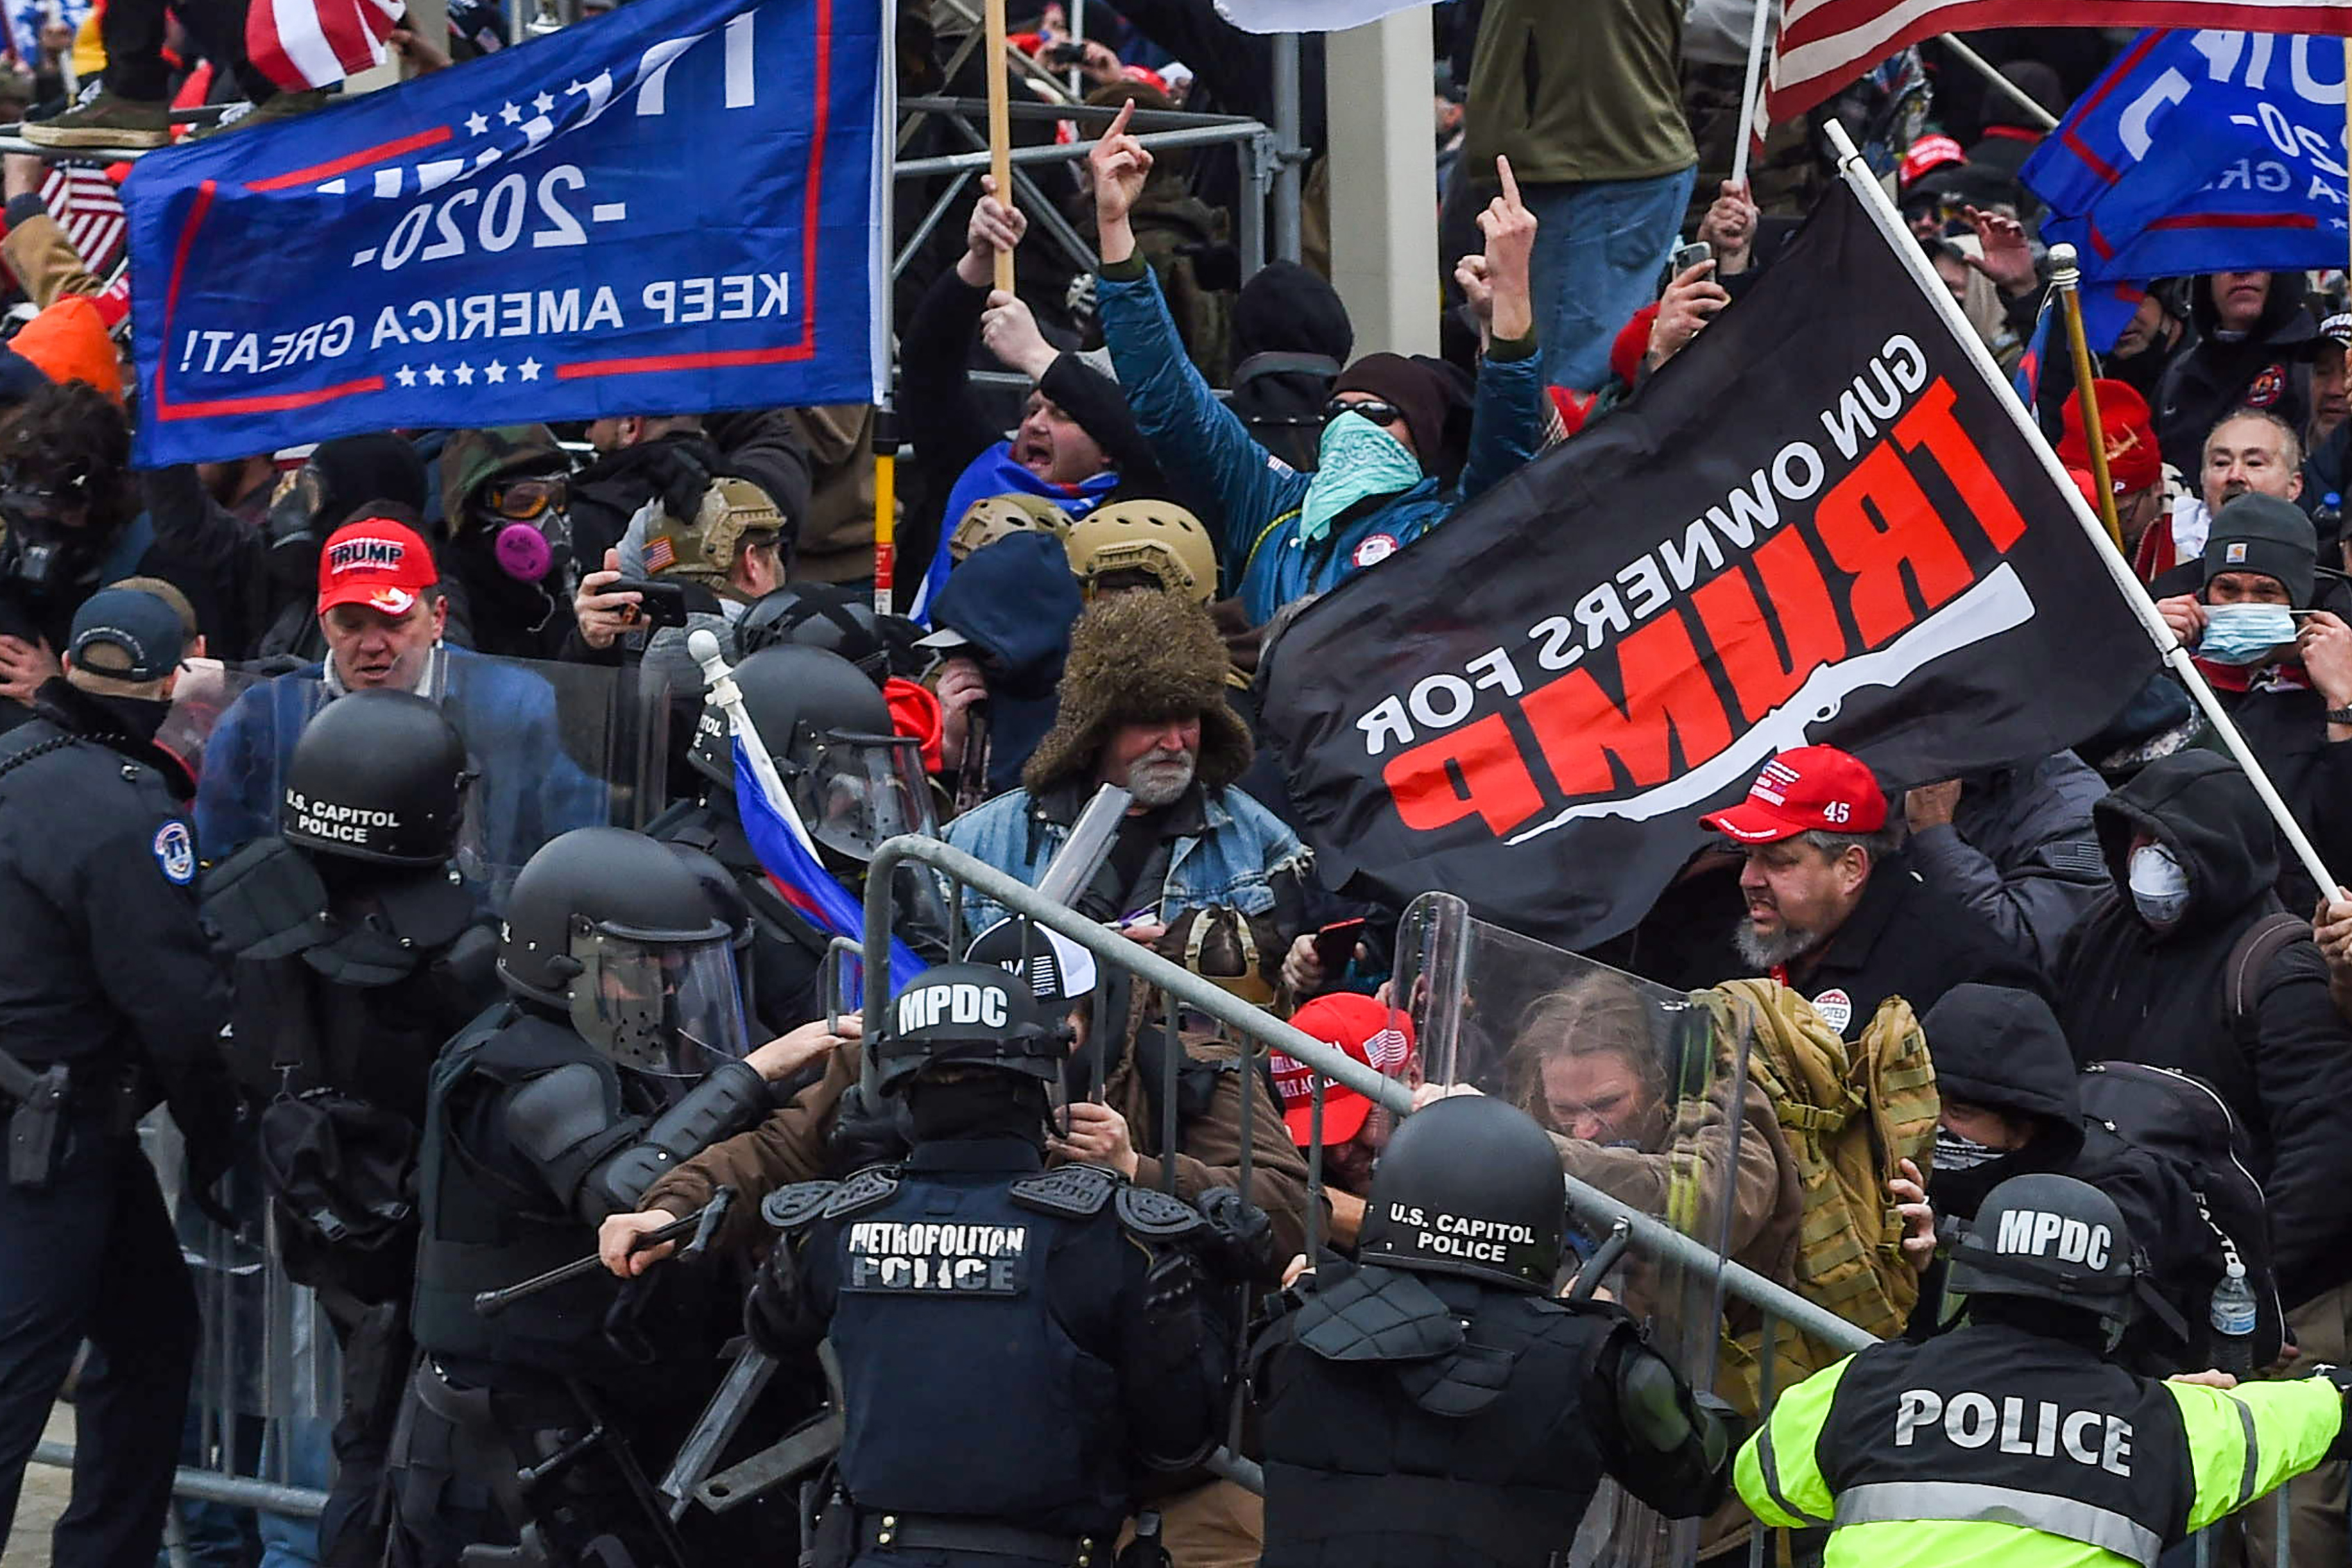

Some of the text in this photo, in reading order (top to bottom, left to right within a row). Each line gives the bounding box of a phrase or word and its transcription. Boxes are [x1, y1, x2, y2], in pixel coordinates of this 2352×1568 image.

[328, 543, 404, 567] TRUMP
[298, 814, 368, 843] POLICE
[312, 801, 401, 827] CAPITOL
[1823, 801, 1851, 823] 45
[898, 983, 1008, 1037] MPDC
[849, 1223, 1026, 1257] METROPOLITAN
[1390, 1203, 1535, 1243] U.S. CAPITOL
[1996, 1209, 2111, 1270] MPDC
[1417, 1231, 1507, 1262] POLICE
[853, 1256, 1015, 1290] POLICE
[1895, 1389, 2133, 1478] POLICE
